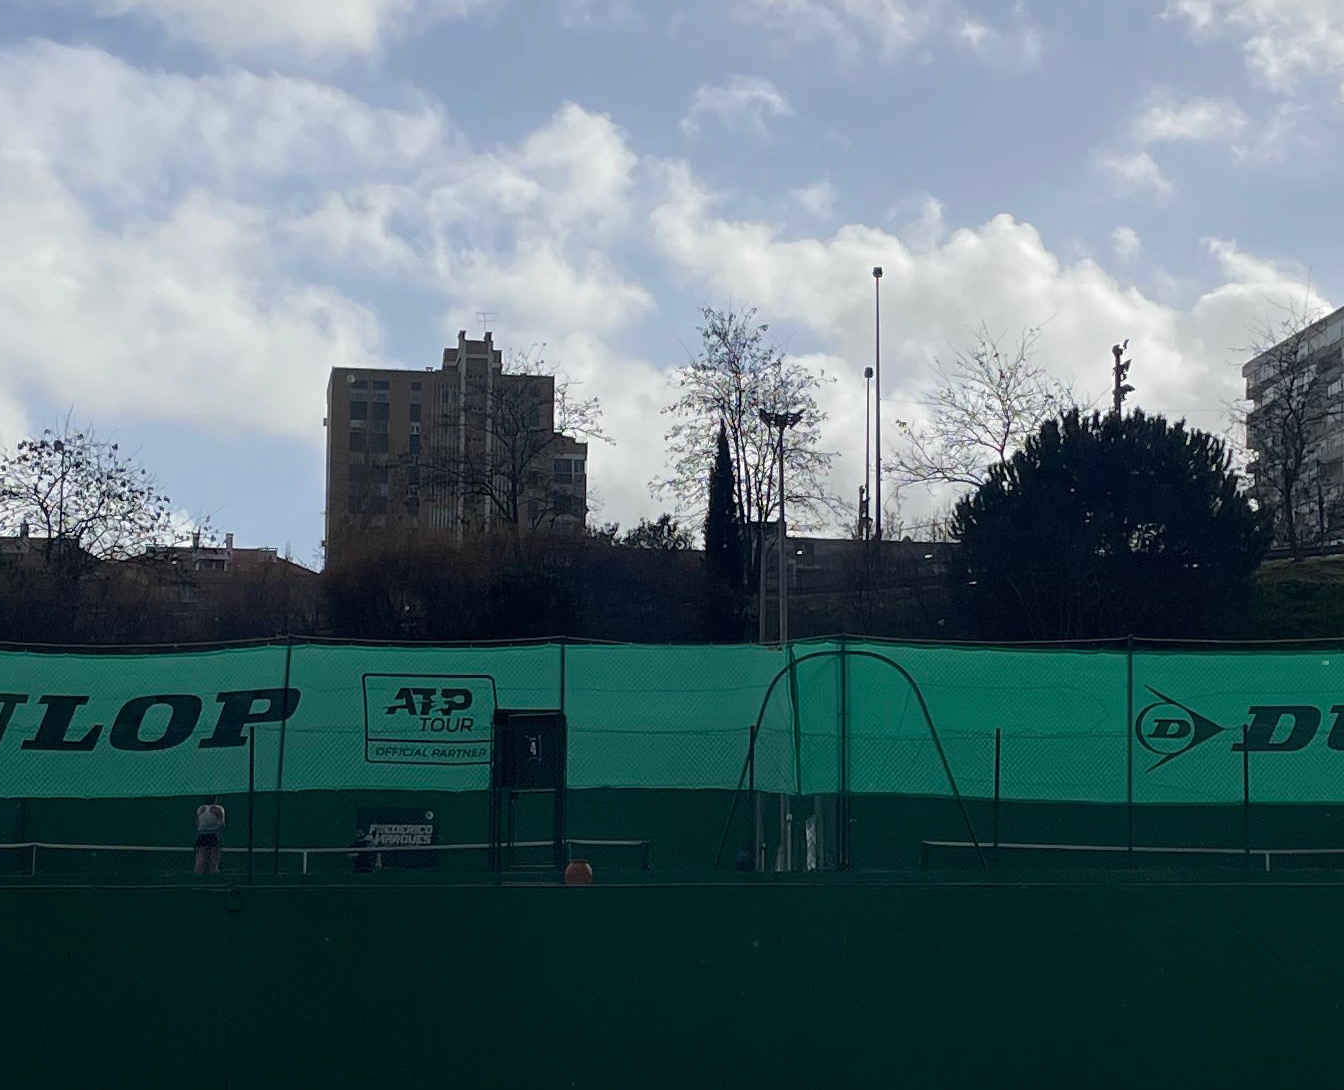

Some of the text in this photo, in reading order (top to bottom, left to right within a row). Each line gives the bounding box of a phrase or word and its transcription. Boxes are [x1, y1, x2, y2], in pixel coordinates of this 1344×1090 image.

[383, 687, 473, 716] ATP
[419, 717, 474, 733] TOUR
[1147, 719, 1191, 739] D
[376, 746, 487, 759] OFFICIAL PARTNER
